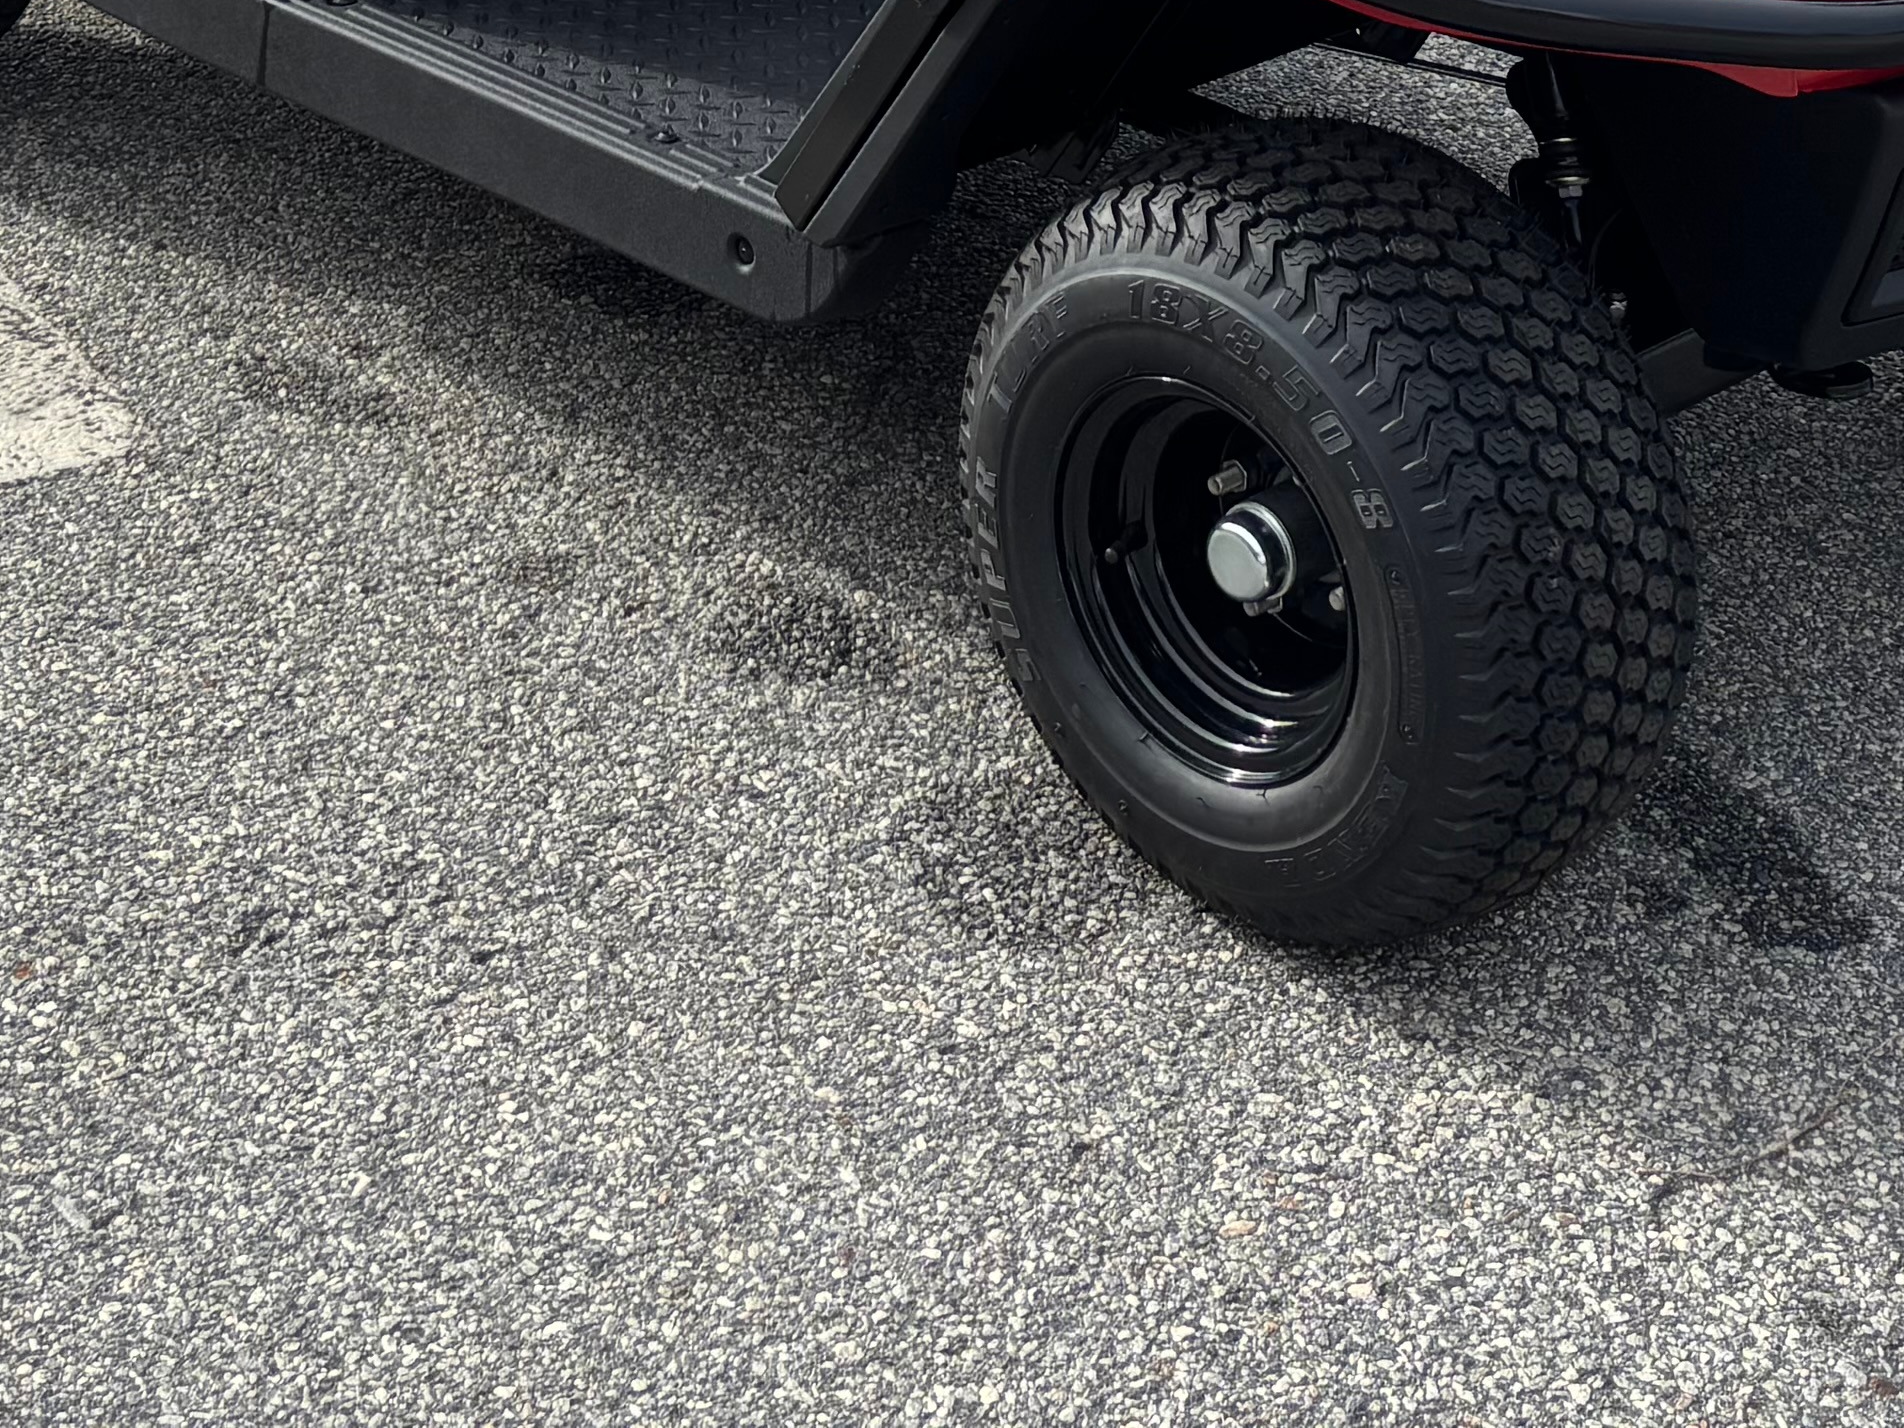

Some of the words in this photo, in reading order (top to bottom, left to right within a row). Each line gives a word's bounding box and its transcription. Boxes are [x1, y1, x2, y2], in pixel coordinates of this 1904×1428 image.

[987, 291, 1068, 414] TURF
[1127, 279, 1394, 529] 18X8.50-8
[975, 456, 1041, 683] SUPER
